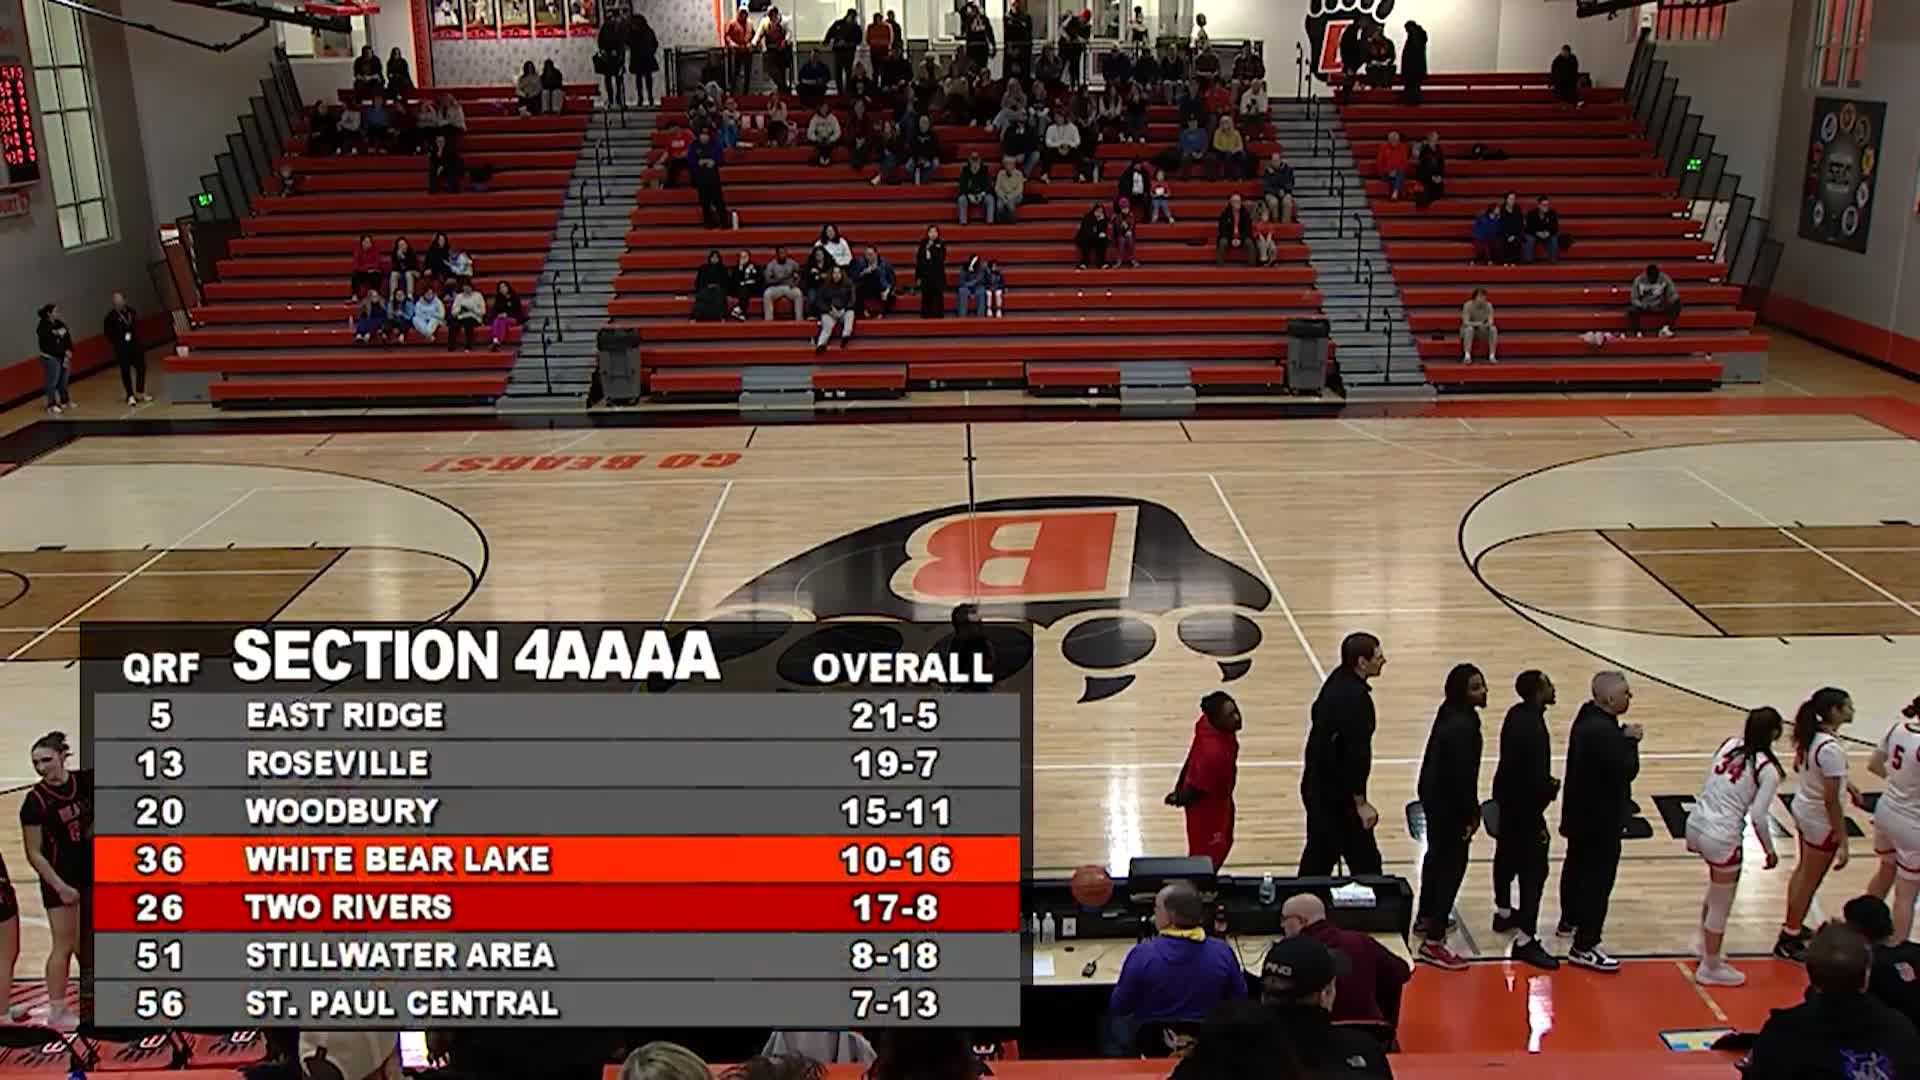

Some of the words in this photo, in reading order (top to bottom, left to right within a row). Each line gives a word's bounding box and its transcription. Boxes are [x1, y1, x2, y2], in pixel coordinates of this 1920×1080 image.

[655, 452, 743, 470] GO
[1714, 752, 1745, 785] 34
[1891, 743, 1906, 771] 5
